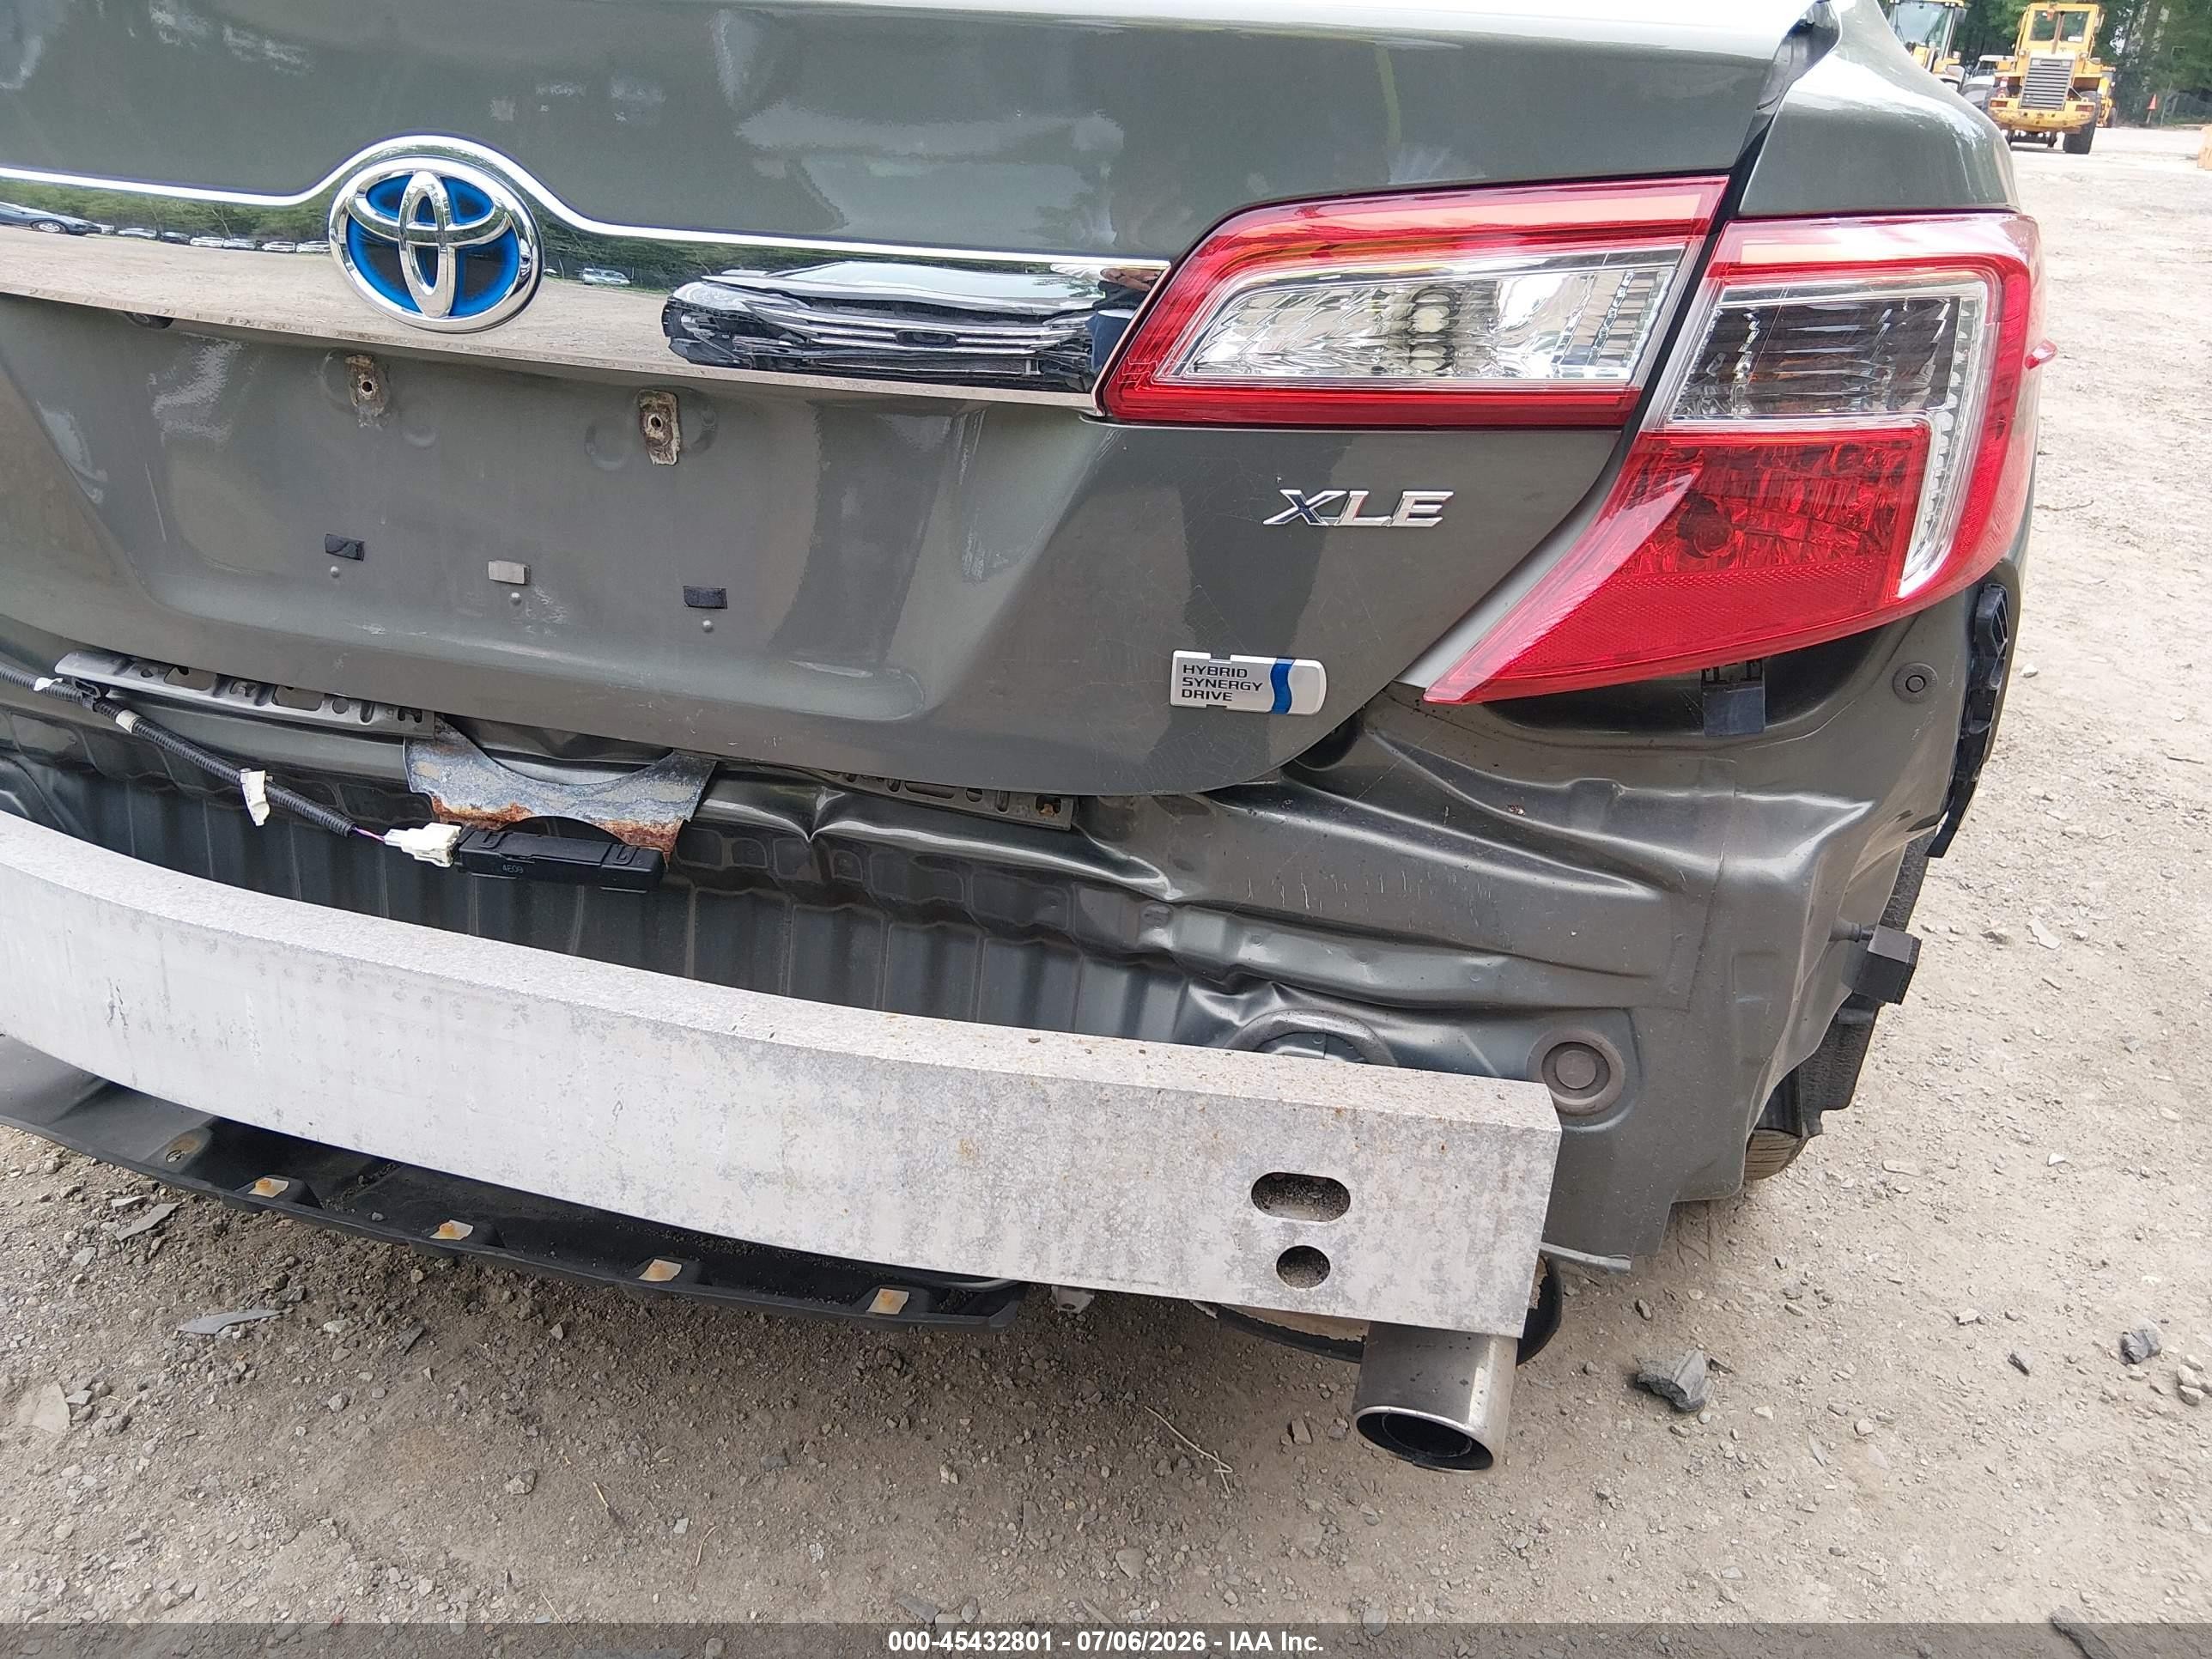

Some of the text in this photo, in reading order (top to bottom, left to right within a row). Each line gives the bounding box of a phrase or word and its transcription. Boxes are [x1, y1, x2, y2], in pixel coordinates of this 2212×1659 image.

[1263, 489, 1455, 528] XLE
[1182, 664, 1248, 678] HYBRID
[1182, 677, 1263, 691] SYNERGY
[1181, 689, 1233, 702] DRIVE
